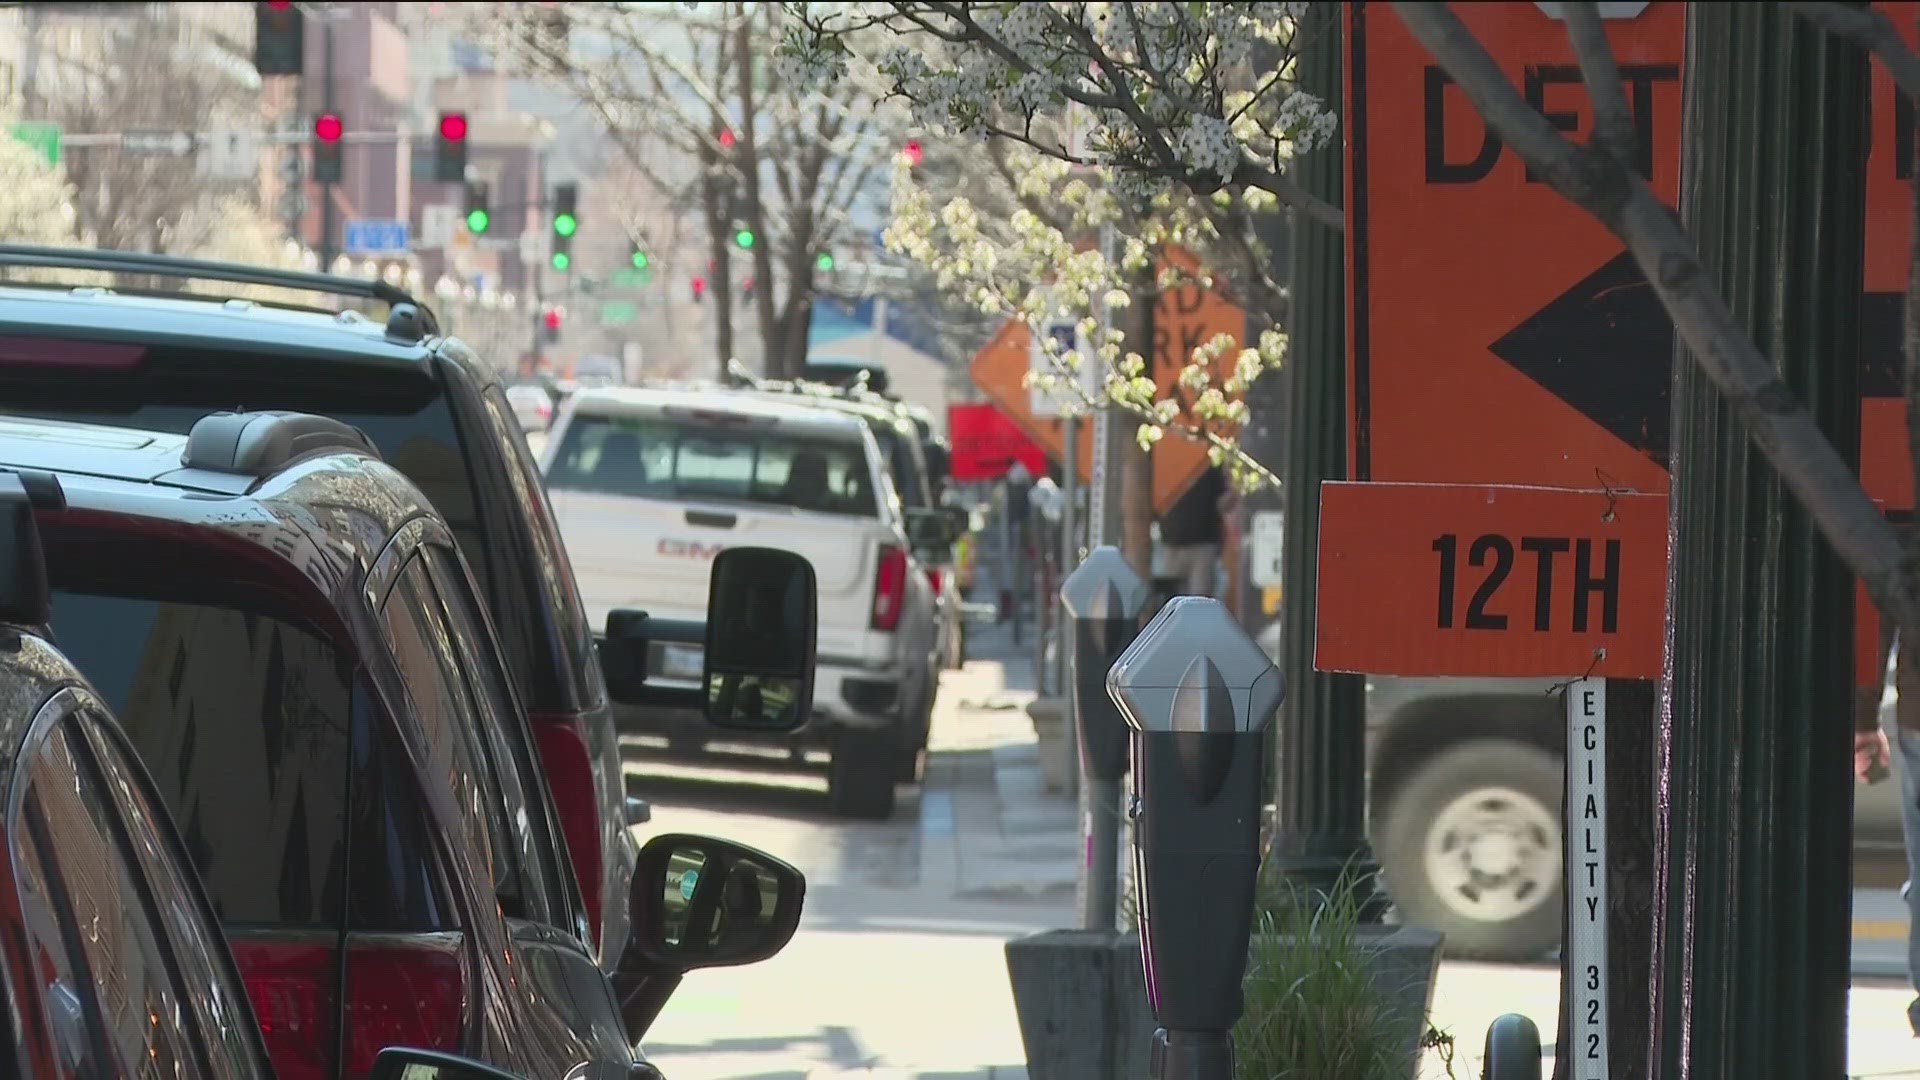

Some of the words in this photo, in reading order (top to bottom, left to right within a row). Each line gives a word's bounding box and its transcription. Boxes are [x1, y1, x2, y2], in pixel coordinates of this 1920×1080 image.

[657, 539, 723, 560] GM
[1432, 534, 1621, 634] 12TH
[1583, 691, 1598, 921] ECIALTY
[1586, 965, 1600, 1080] 322
